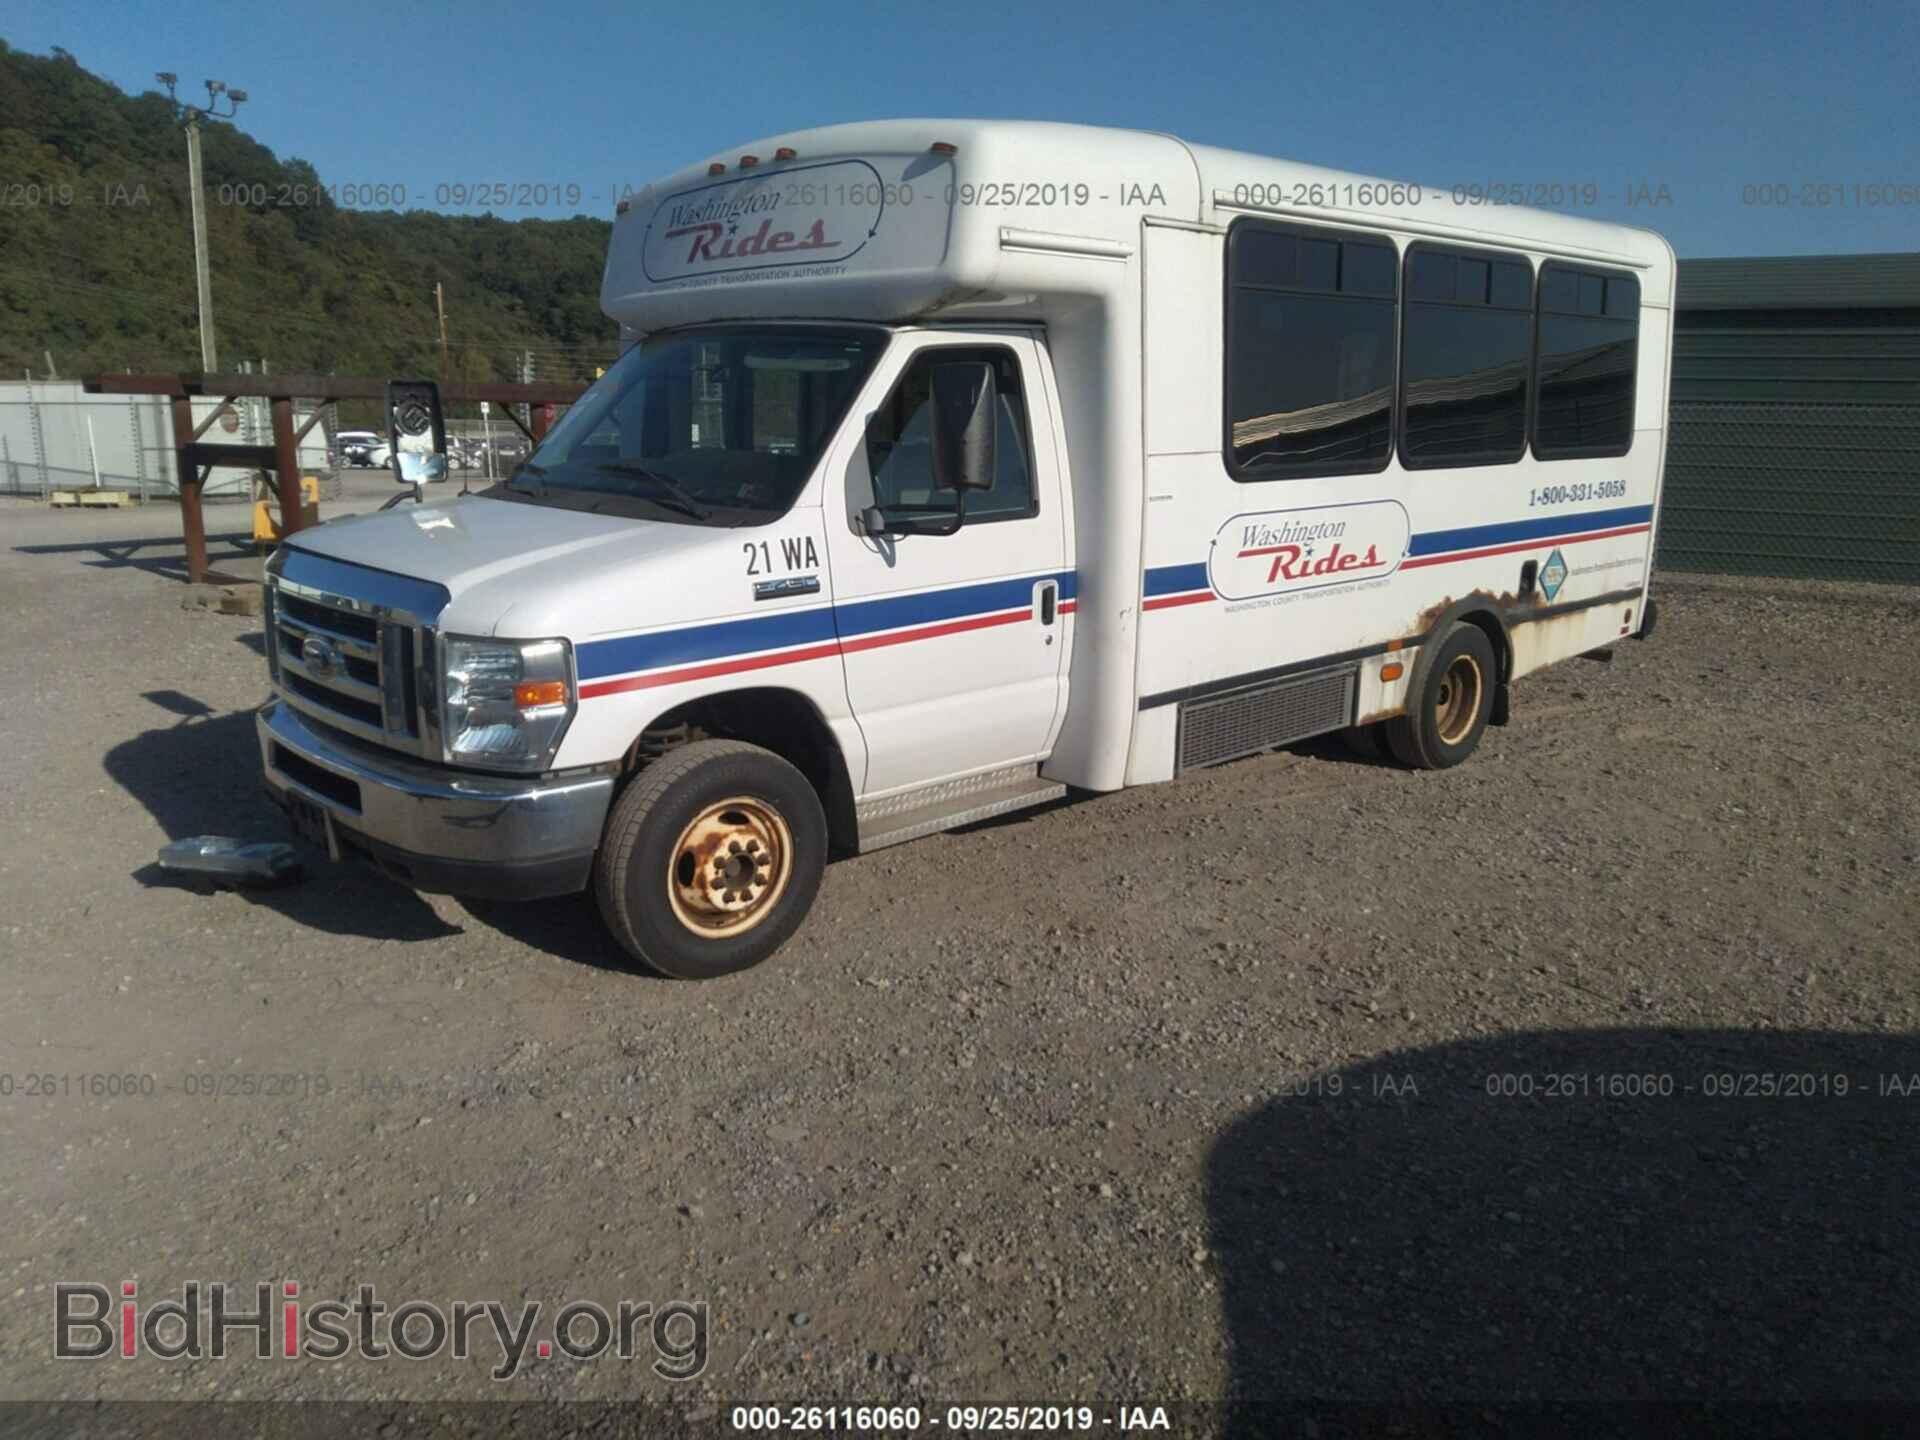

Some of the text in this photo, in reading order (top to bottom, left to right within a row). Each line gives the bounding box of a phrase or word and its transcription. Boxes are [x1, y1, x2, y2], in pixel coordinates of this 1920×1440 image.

[669, 192, 782, 227] Washington
[665, 219, 841, 264] Rides
[1528, 479, 1627, 506] 1-800-331-5058
[1241, 519, 1347, 548] Washington
[743, 536, 820, 575] 21 WA
[1236, 543, 1387, 583] Rides
